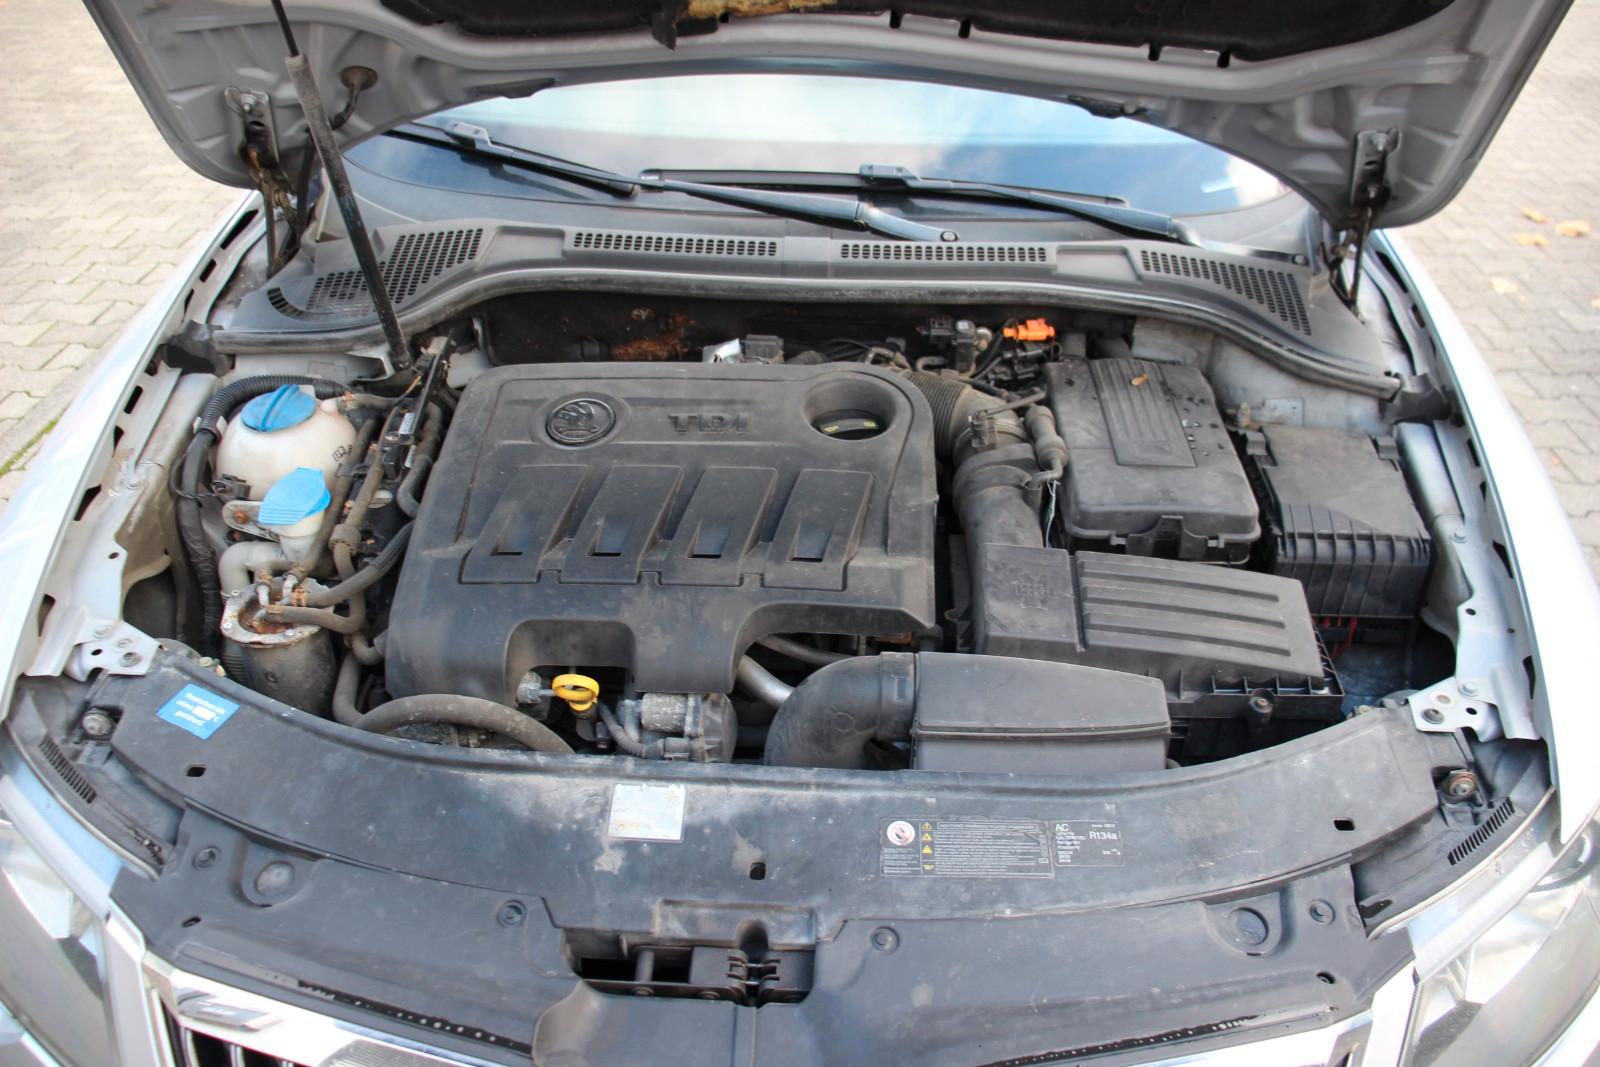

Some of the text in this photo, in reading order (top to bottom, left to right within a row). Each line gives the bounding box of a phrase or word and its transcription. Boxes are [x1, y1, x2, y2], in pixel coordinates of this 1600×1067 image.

[668, 412, 749, 433] TDI
[1055, 823, 1069, 832] AC
[1089, 831, 1118, 840] R134a
